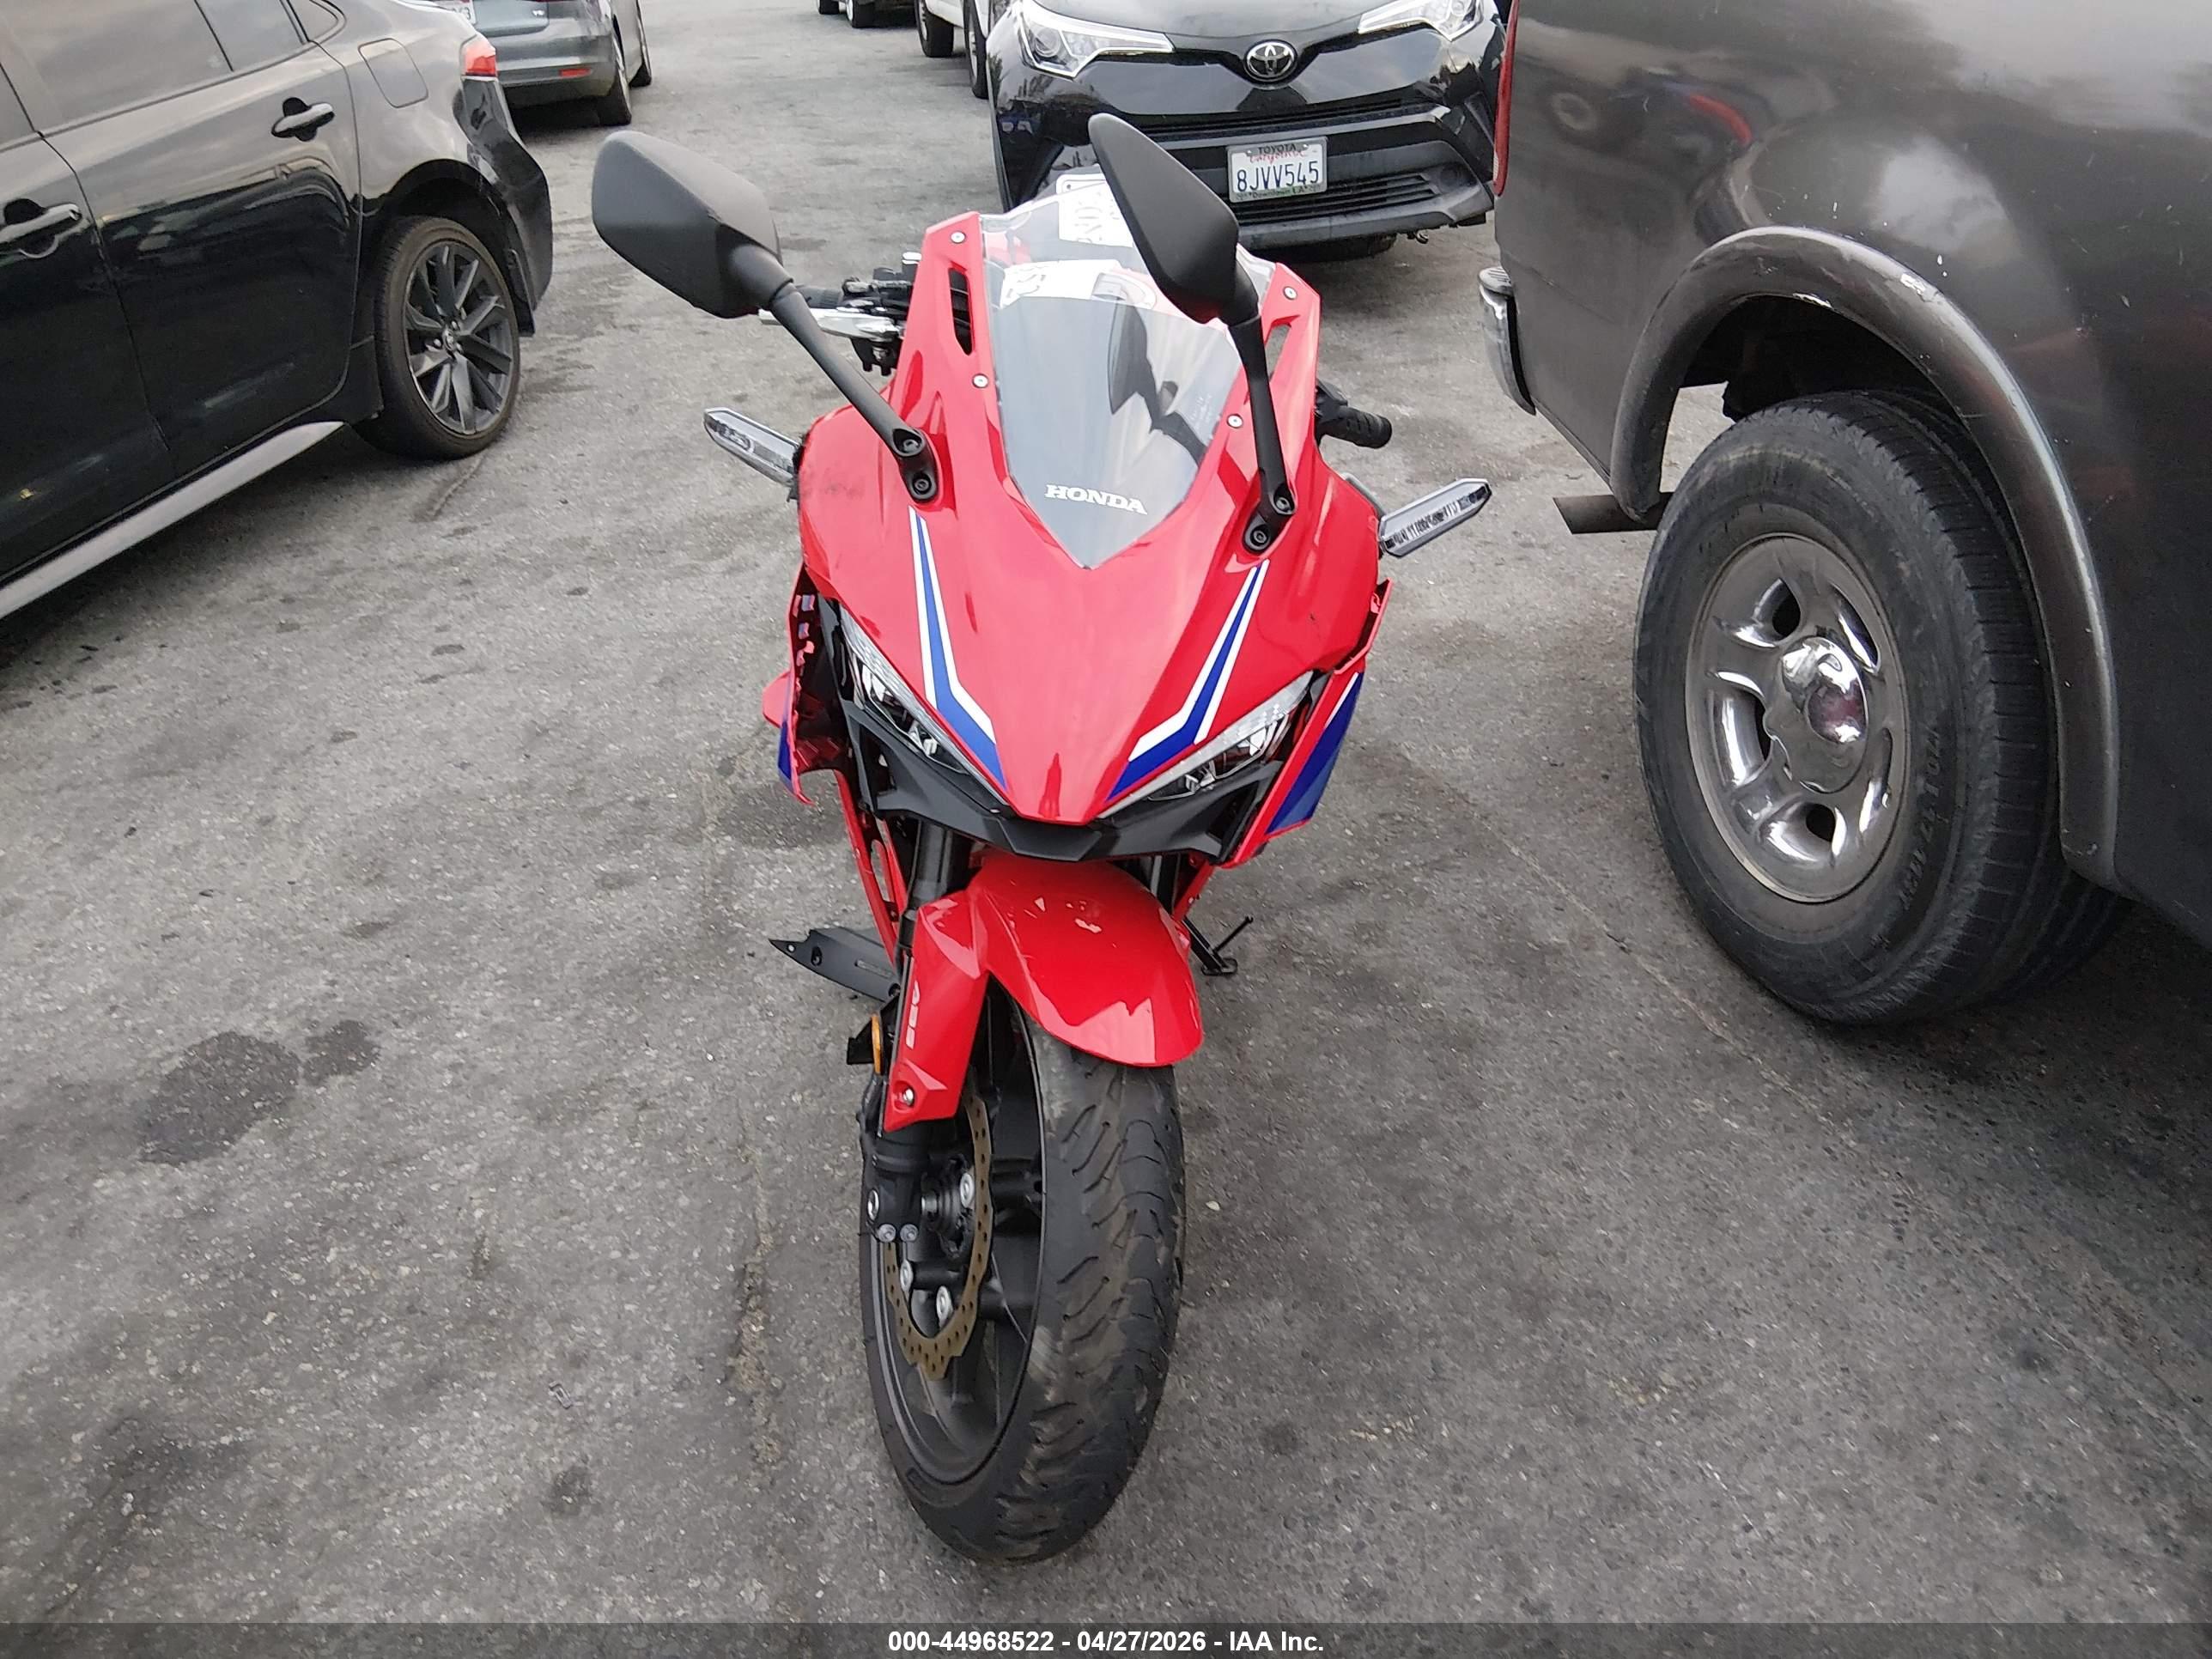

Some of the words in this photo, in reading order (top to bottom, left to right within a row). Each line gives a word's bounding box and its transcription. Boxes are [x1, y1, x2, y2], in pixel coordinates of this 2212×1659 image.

[1258, 143, 1297, 154] TOYOTA
[1237, 161, 1319, 192] 8JVV545
[1044, 484, 1148, 515] HONDA
